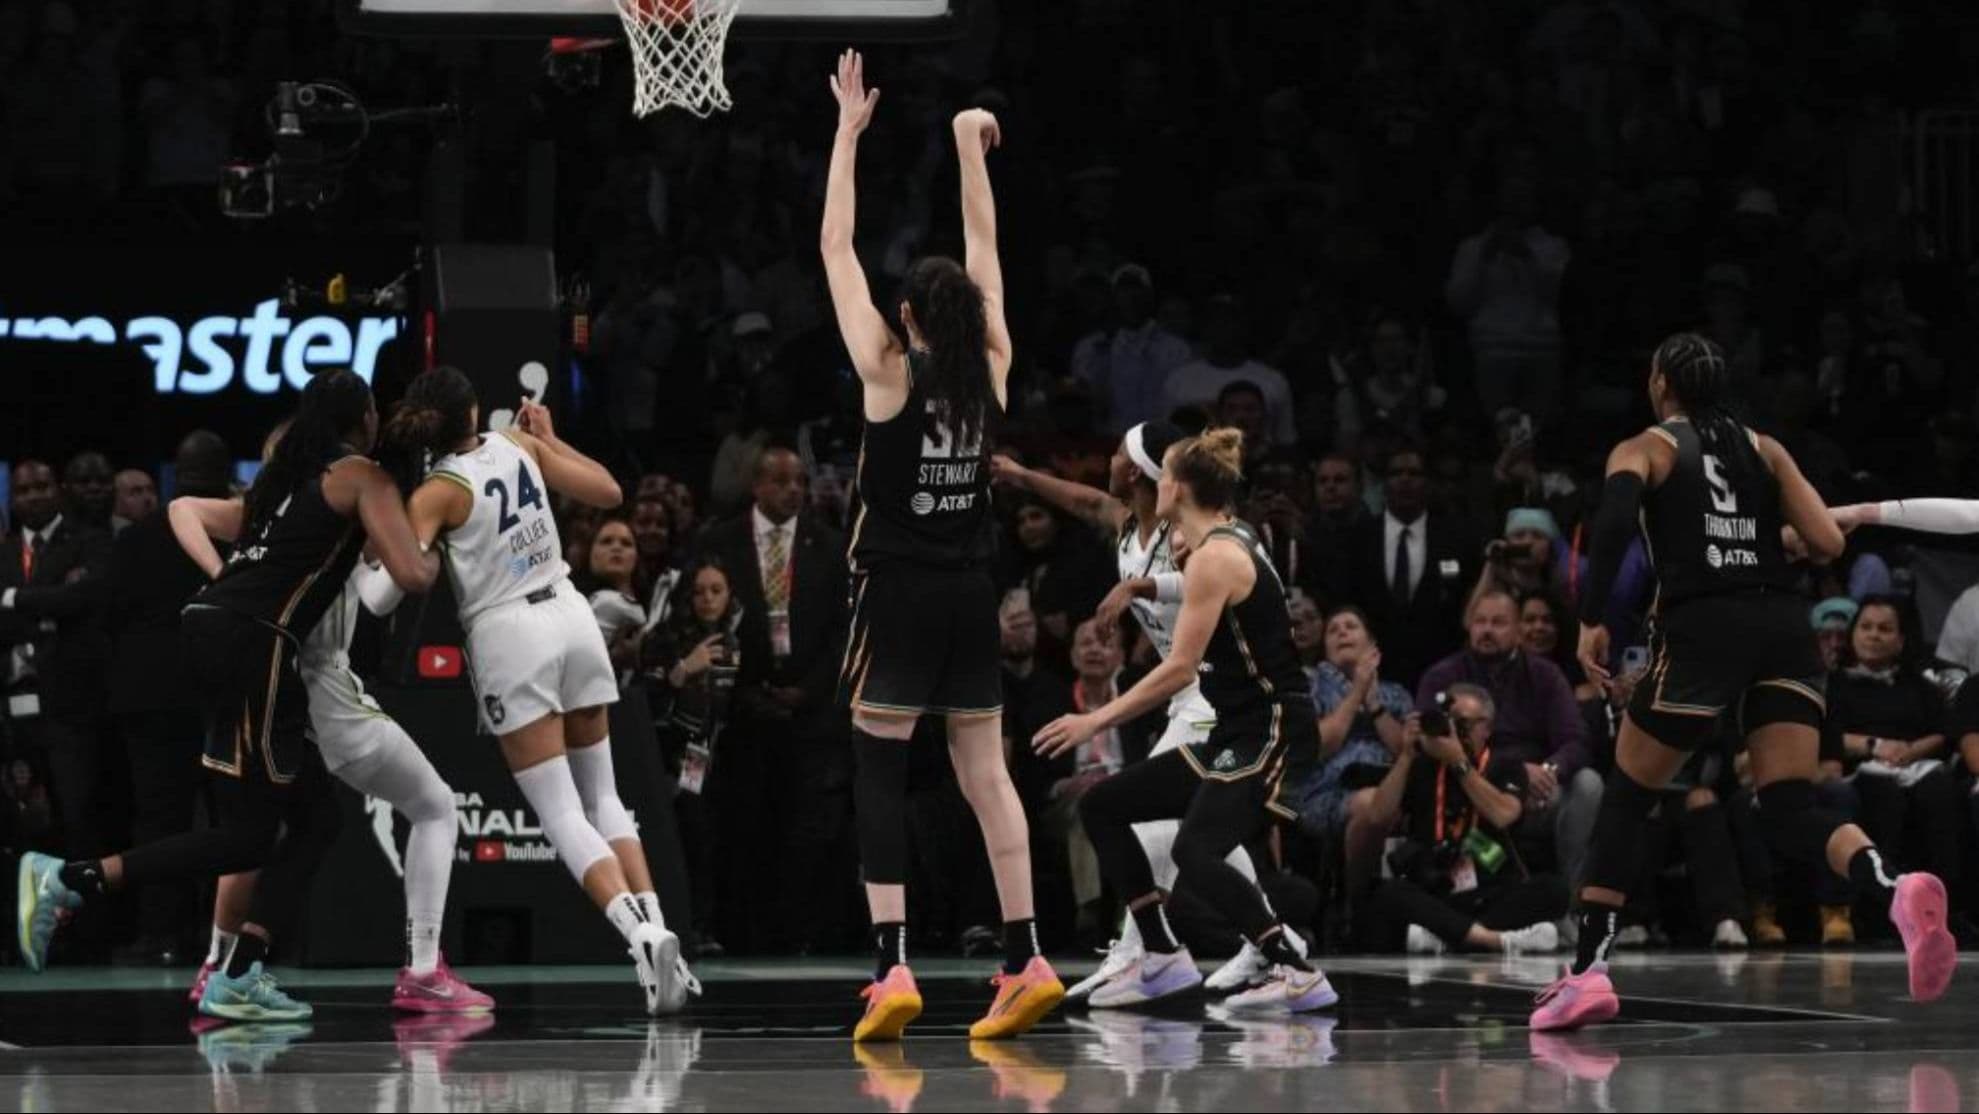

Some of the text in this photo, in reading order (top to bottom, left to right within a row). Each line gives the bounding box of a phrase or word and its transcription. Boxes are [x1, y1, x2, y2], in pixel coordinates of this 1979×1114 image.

[918, 461, 980, 486] STEWART
[1702, 453, 1738, 513] 5
[485, 458, 544, 535] 24
[936, 492, 977, 512] AT&T
[1703, 512, 1757, 541] THORNTON
[504, 842, 557, 861] YouTube
